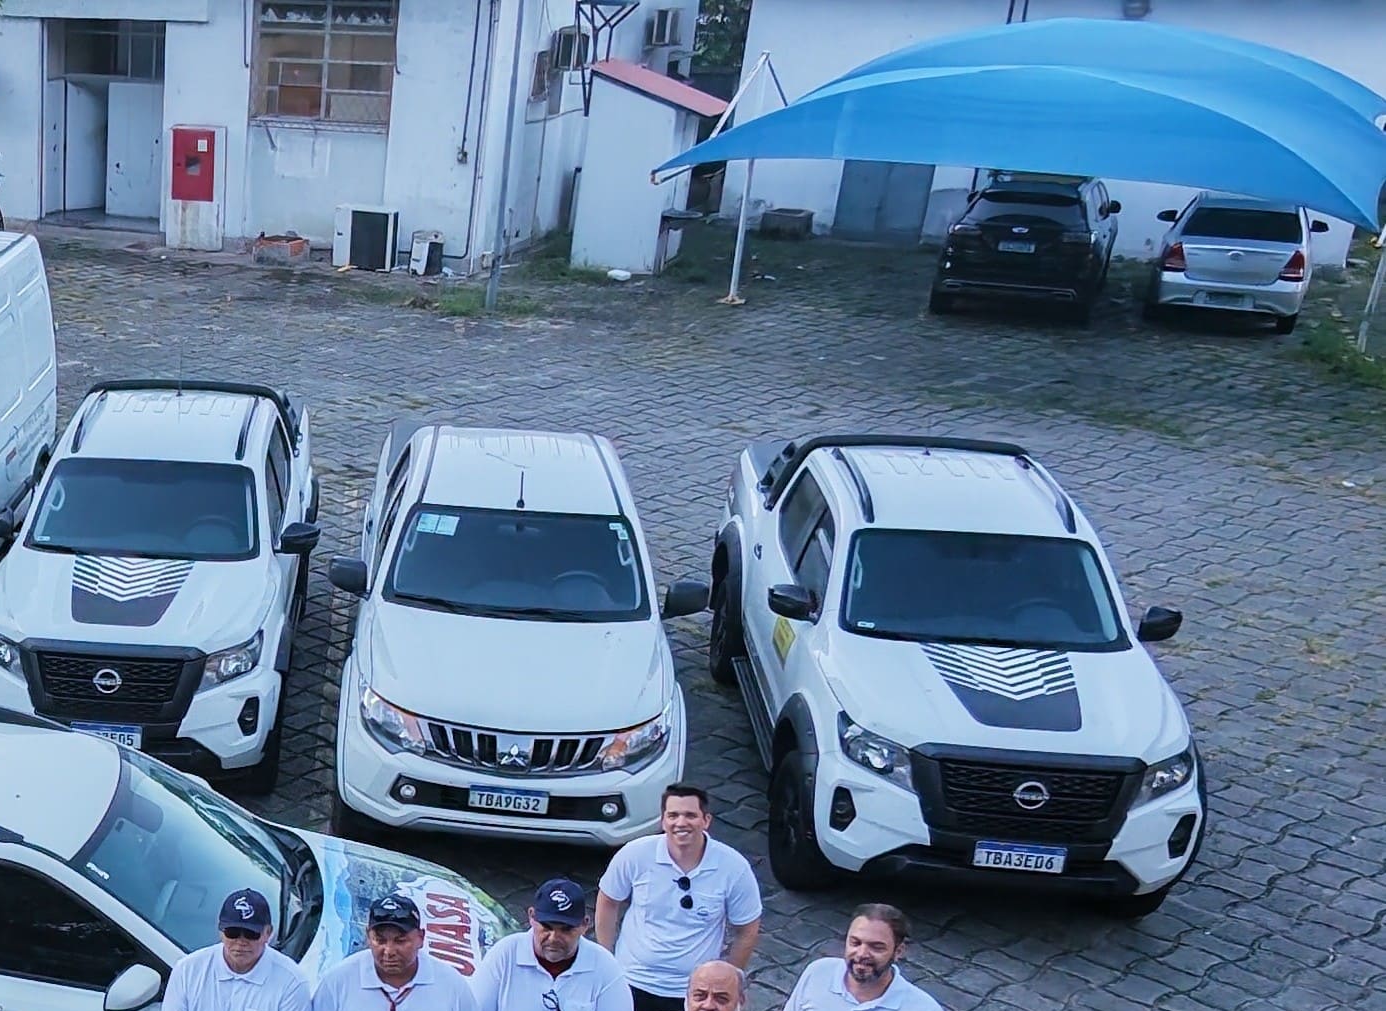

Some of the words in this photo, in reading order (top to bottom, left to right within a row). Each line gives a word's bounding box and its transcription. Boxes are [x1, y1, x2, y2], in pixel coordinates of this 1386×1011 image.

[477, 793, 540, 812] TBA9G32
[985, 851, 1055, 870] TBA3E06
[426, 893, 475, 977] UNASA
